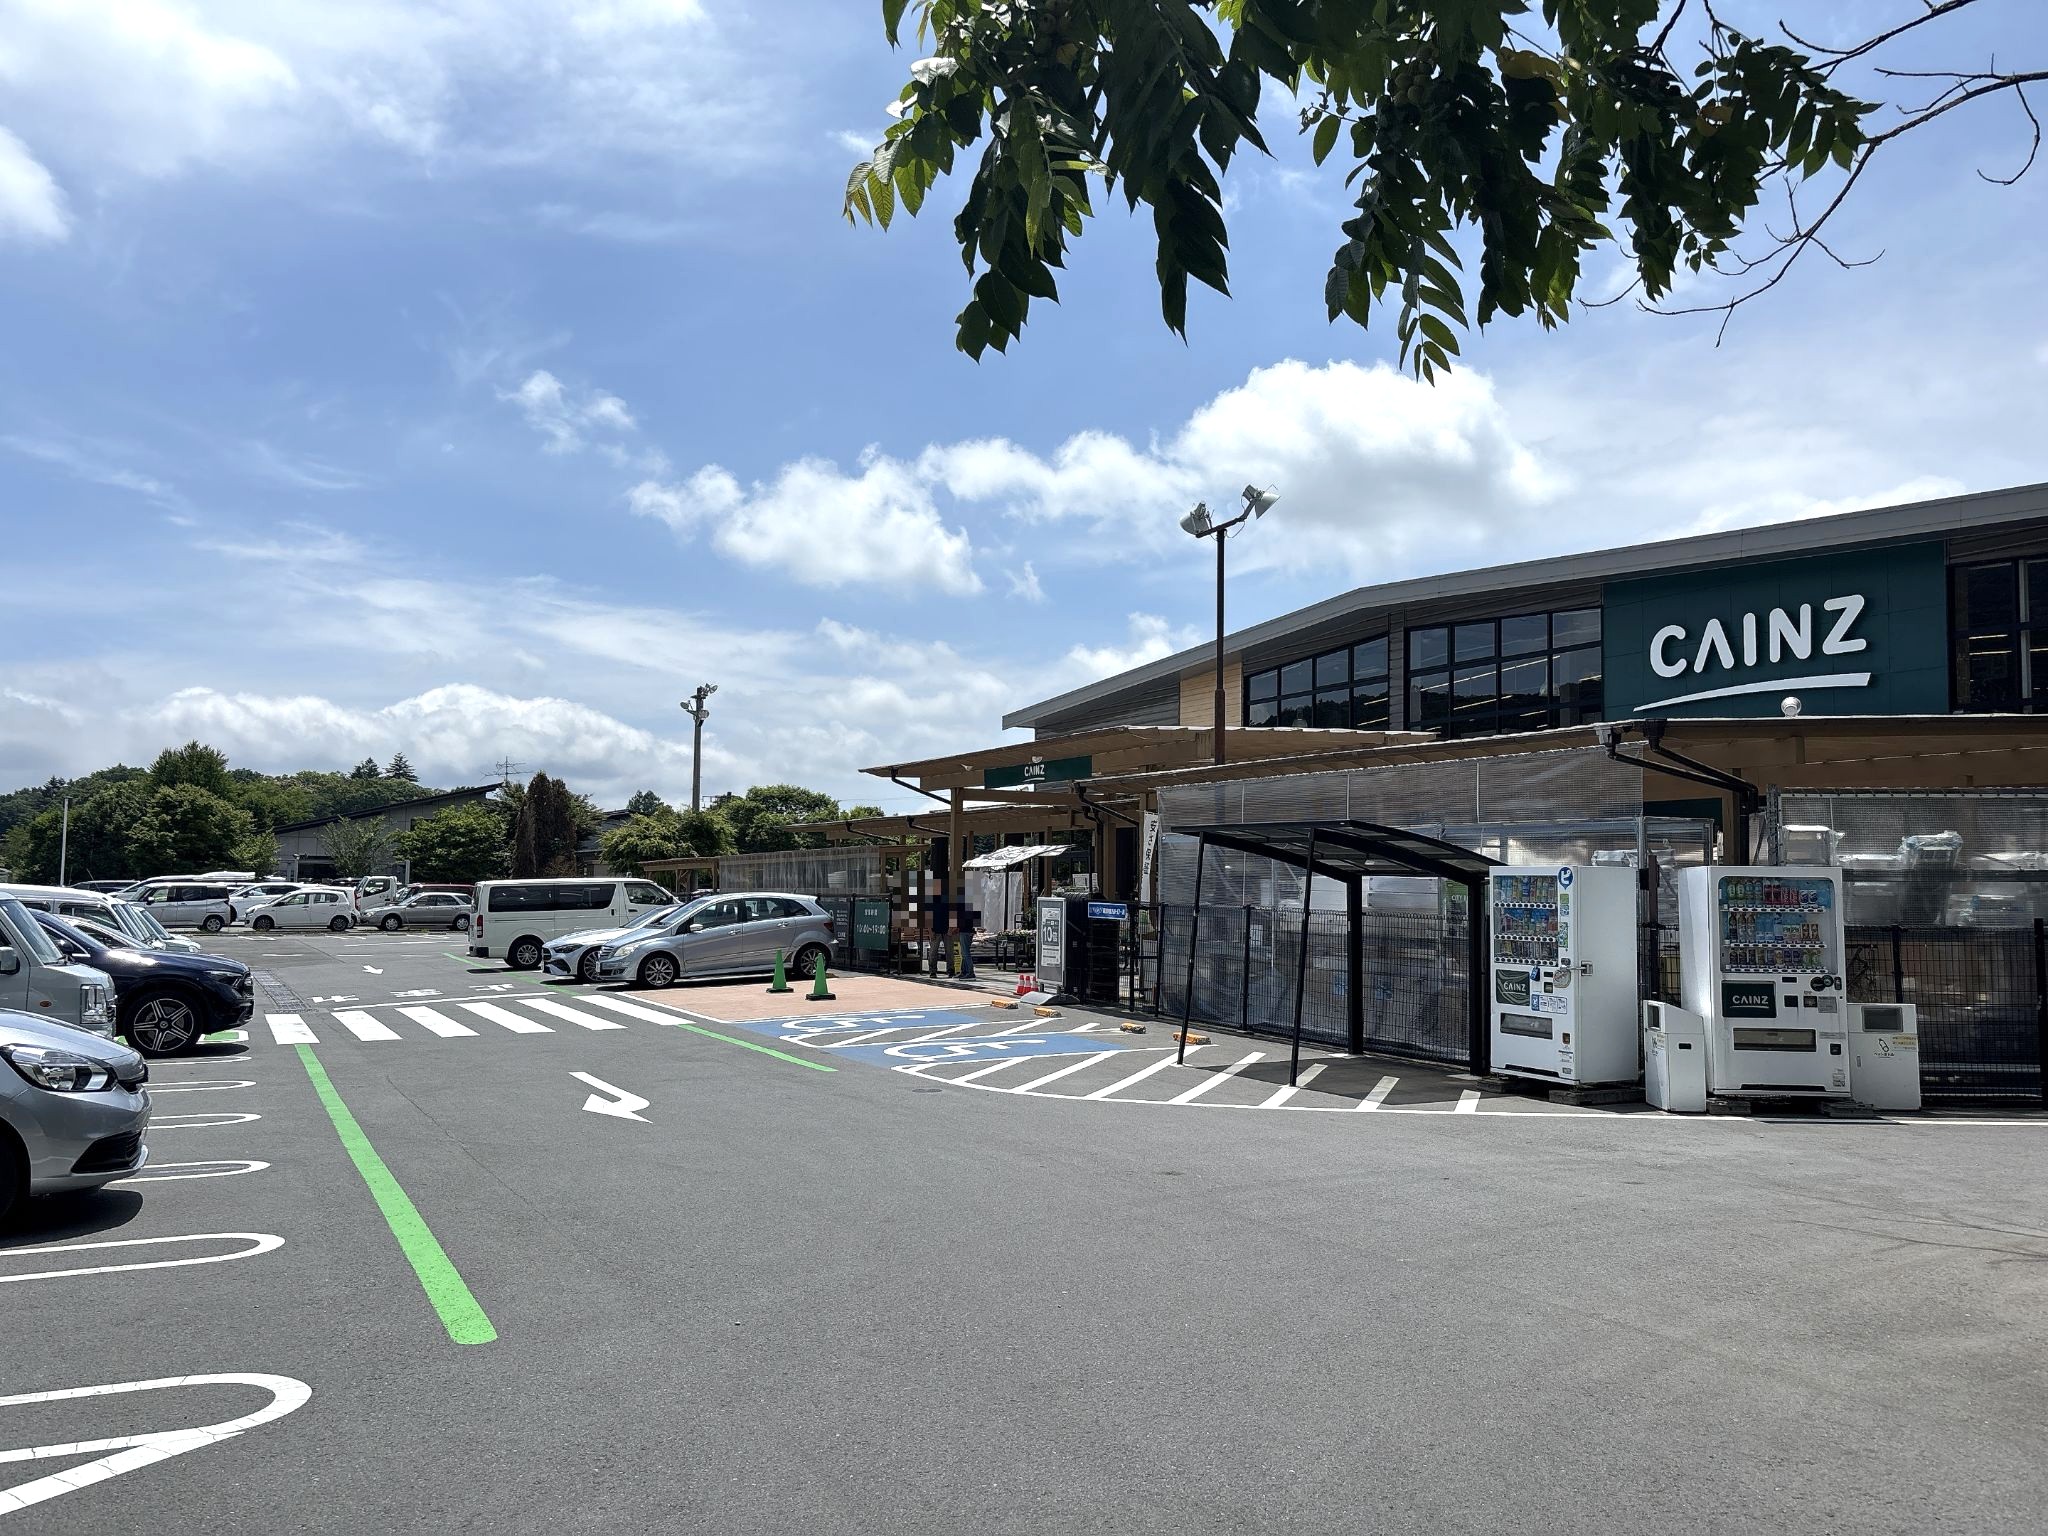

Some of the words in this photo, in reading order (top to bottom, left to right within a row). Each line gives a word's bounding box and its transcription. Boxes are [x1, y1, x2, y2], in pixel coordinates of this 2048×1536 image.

[1649, 593, 1867, 678] CAINZ
[1024, 764, 1045, 777] CAINZ
[1503, 981, 1527, 992] CAINZ
[1732, 994, 1769, 1005] CAINZ
